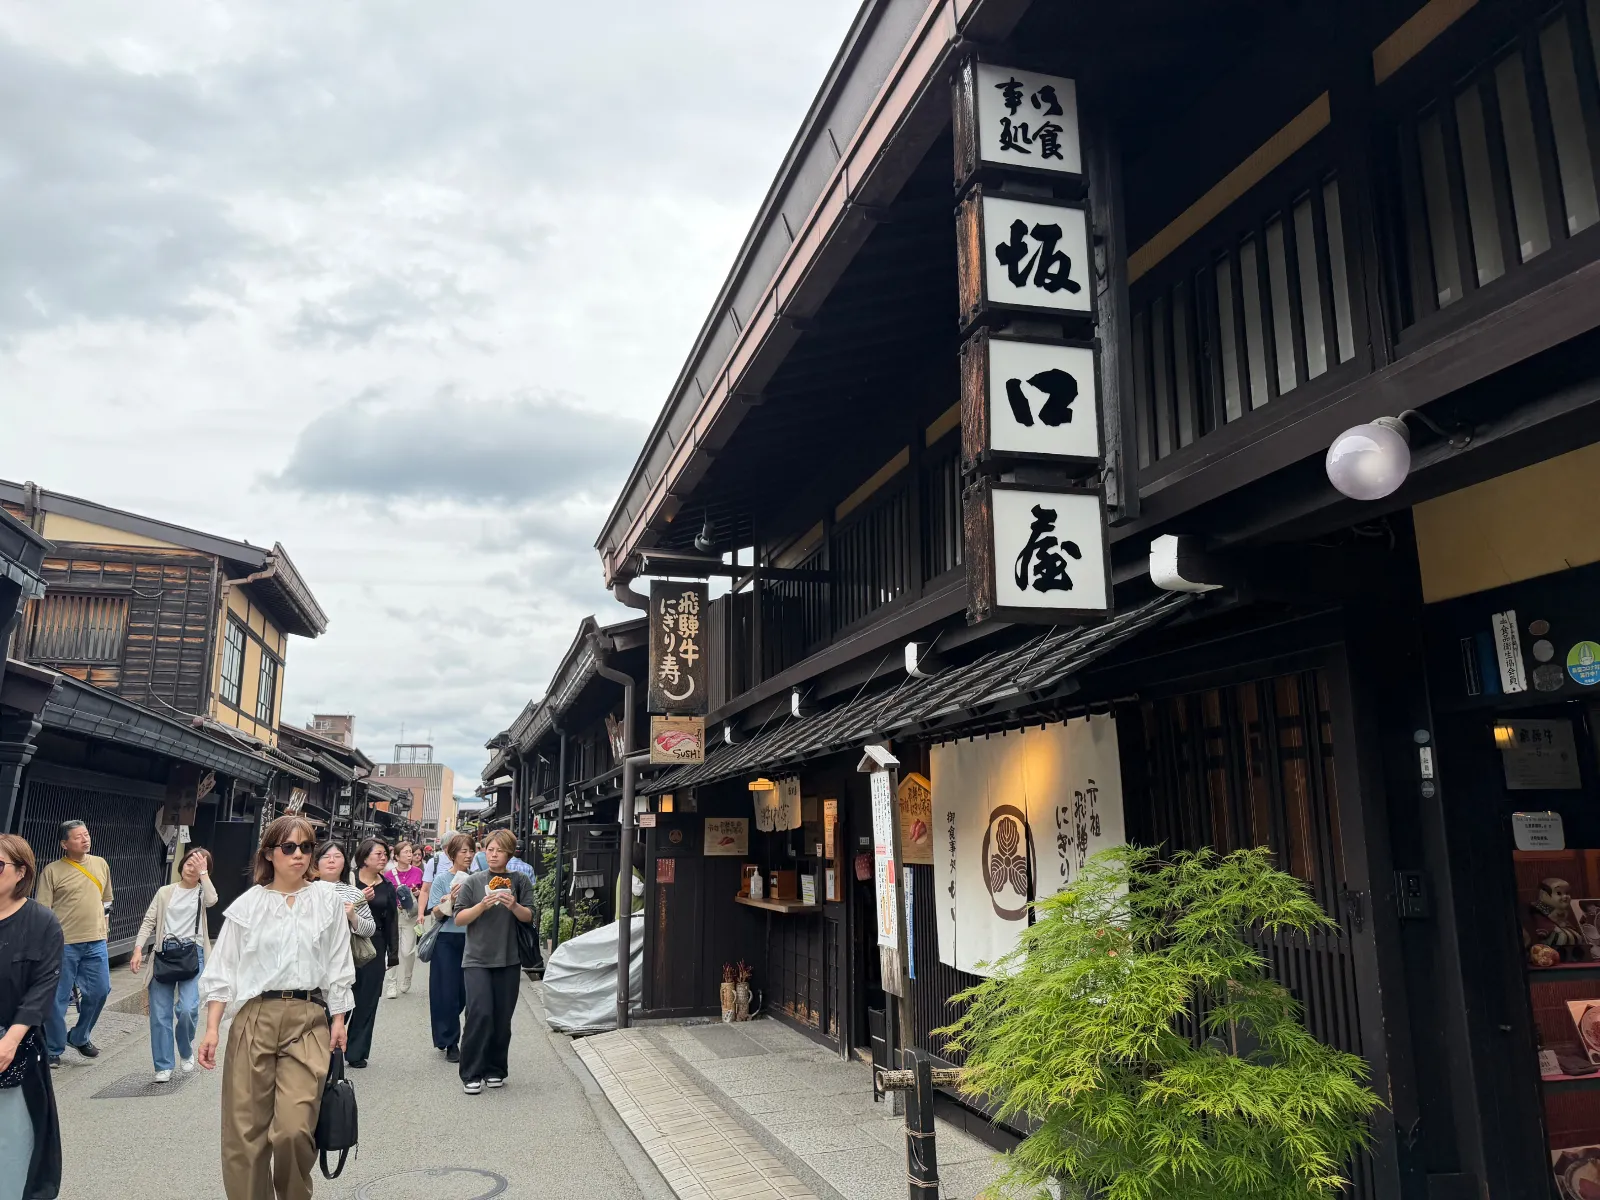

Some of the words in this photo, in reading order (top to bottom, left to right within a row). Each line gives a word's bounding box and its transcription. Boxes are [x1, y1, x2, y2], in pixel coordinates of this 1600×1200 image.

[677, 590, 700, 668] 飛騨牛
[672, 749, 701, 759] SUSHI
[1086, 778, 1102, 837] 元祖
[1055, 805, 1074, 892] にぎり
